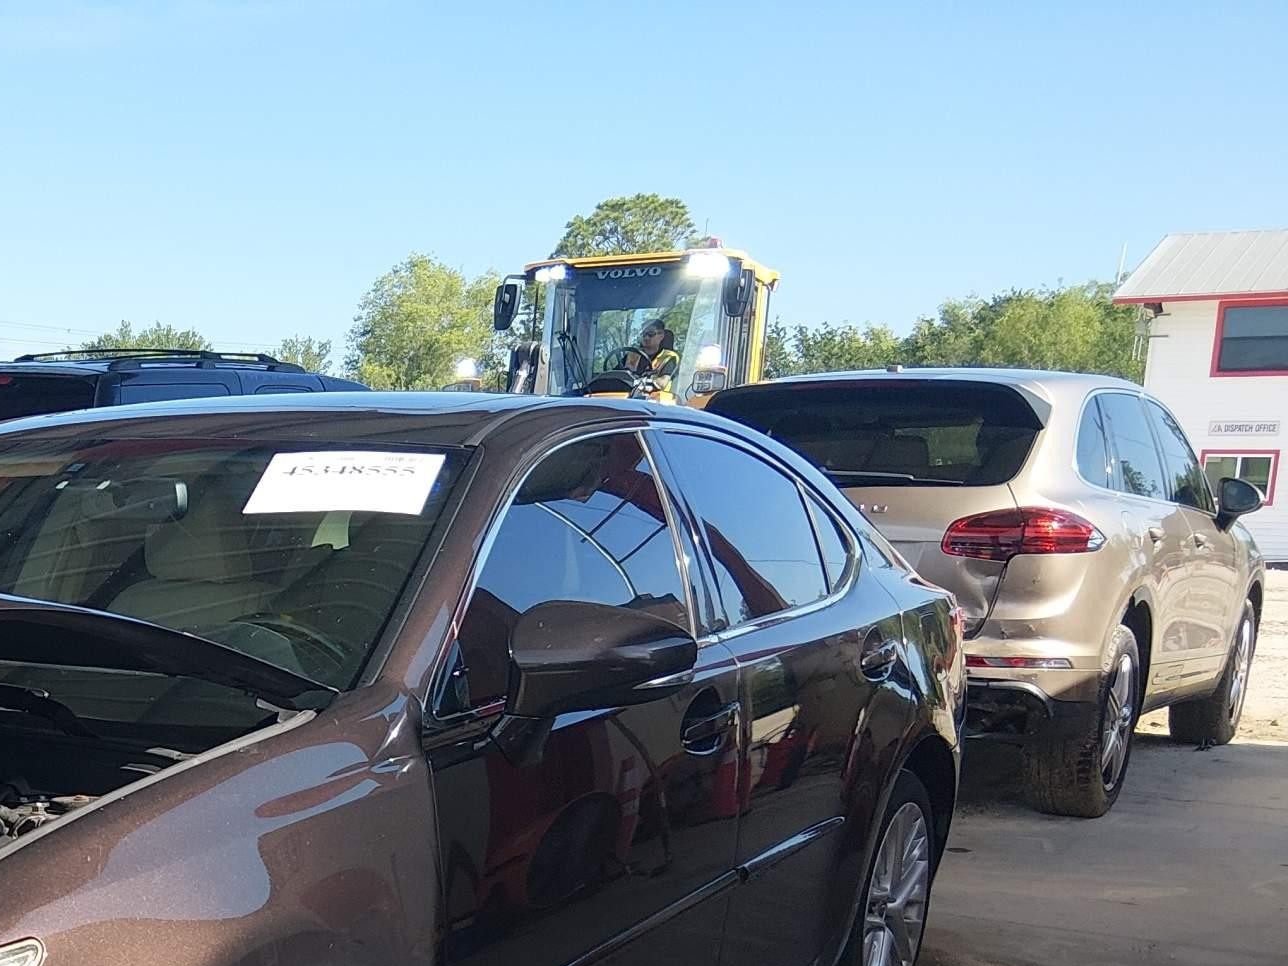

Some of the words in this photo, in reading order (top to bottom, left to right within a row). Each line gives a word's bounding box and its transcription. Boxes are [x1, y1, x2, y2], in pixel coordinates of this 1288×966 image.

[595, 266, 662, 279] VOLVO
[1224, 423, 1253, 433] DISPATCH
[1255, 423, 1277, 433] OFFICE
